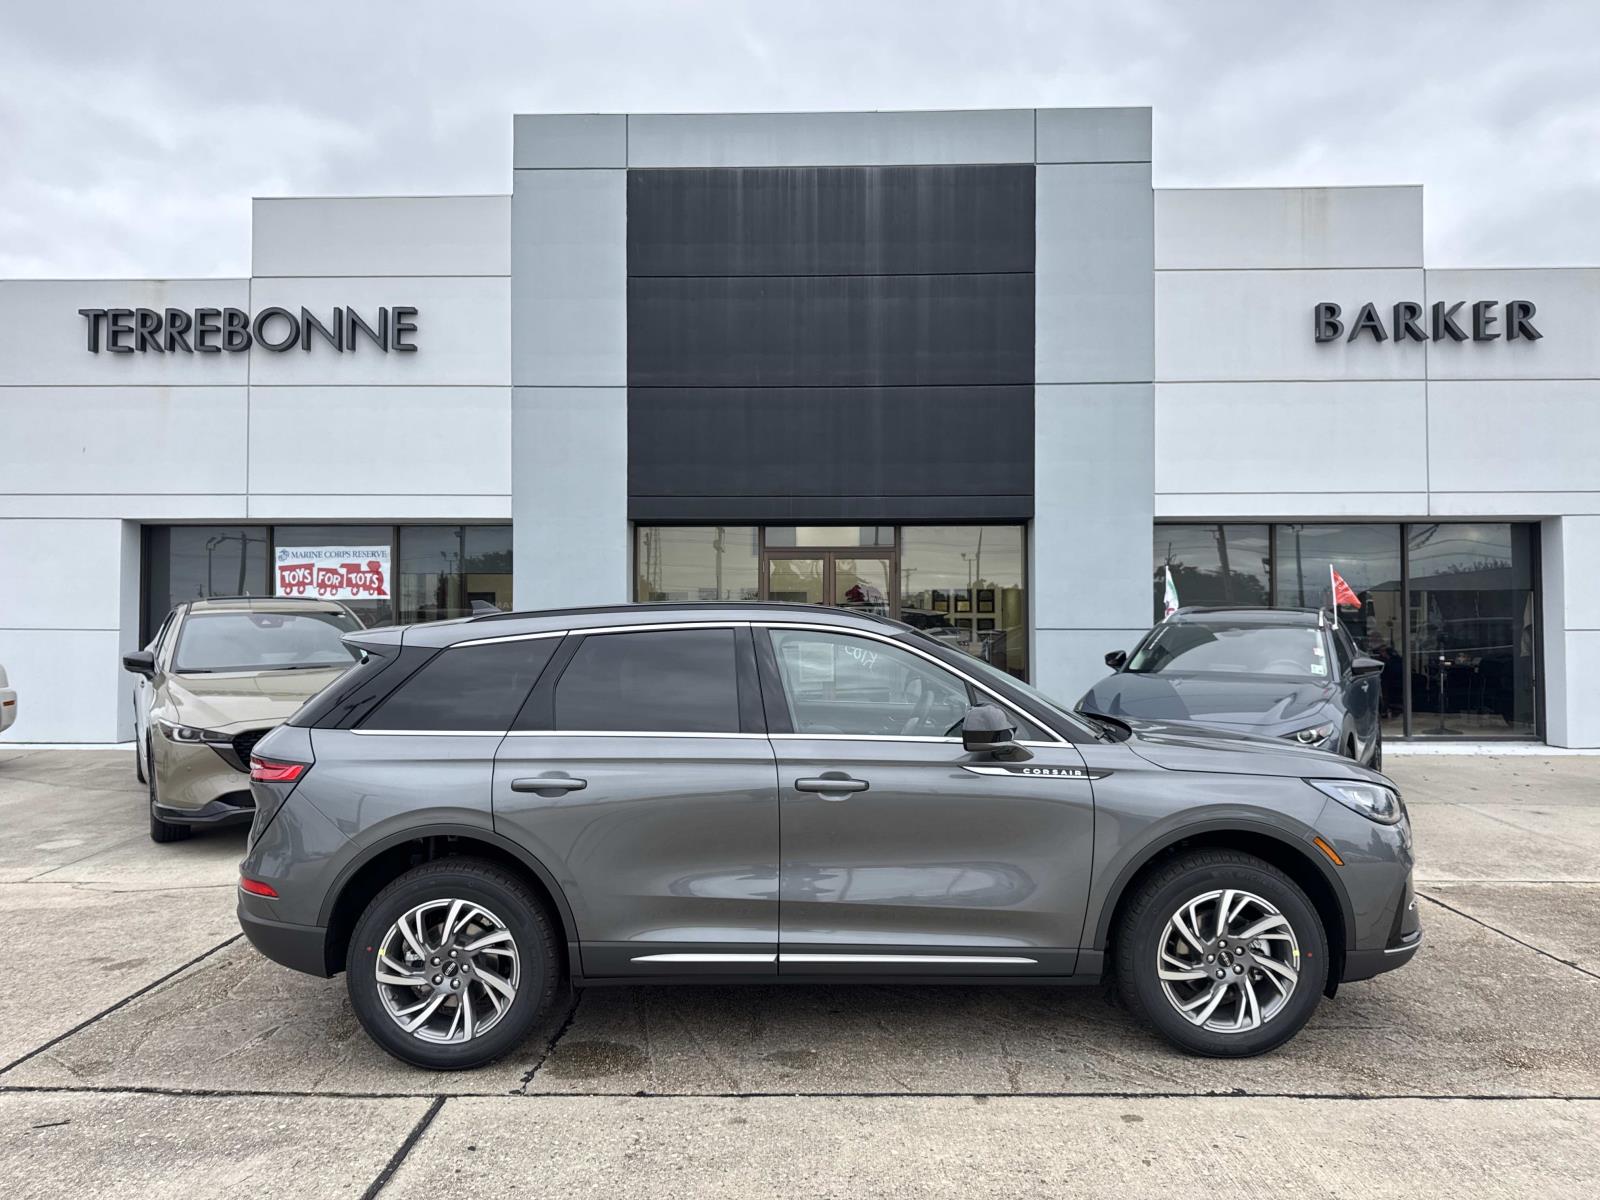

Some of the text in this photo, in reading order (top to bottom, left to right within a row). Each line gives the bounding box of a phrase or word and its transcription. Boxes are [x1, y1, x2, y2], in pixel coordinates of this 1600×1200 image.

[78, 305, 418, 353] TERREBONNE
[1314, 300, 1544, 343] BARKER
[291, 550, 388, 559] MARINE CORPS RESERVE
[282, 568, 379, 588] TOYS FOR TOTS
[1022, 768, 1083, 776] CORSAIR
